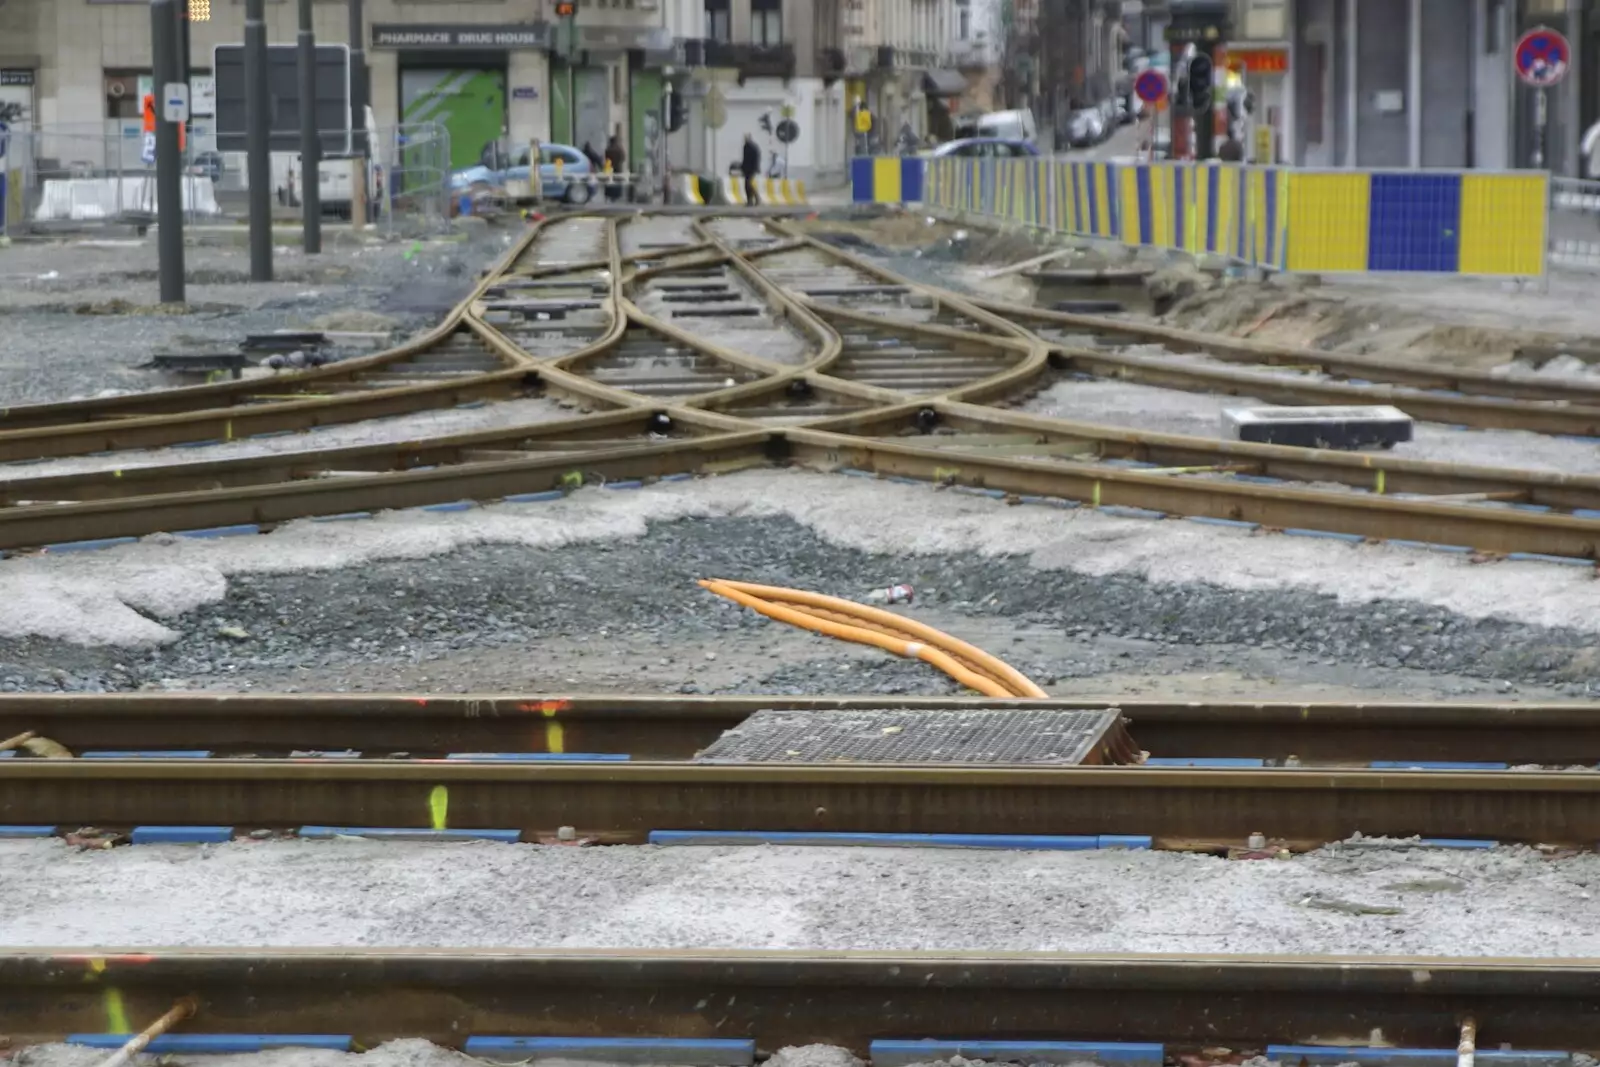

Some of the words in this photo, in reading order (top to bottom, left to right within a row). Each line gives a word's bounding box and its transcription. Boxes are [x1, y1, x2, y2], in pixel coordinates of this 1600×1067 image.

[379, 32, 451, 44] PHARMACIE
[458, 32, 493, 44] DRUG
[495, 32, 536, 44] HOUSE
